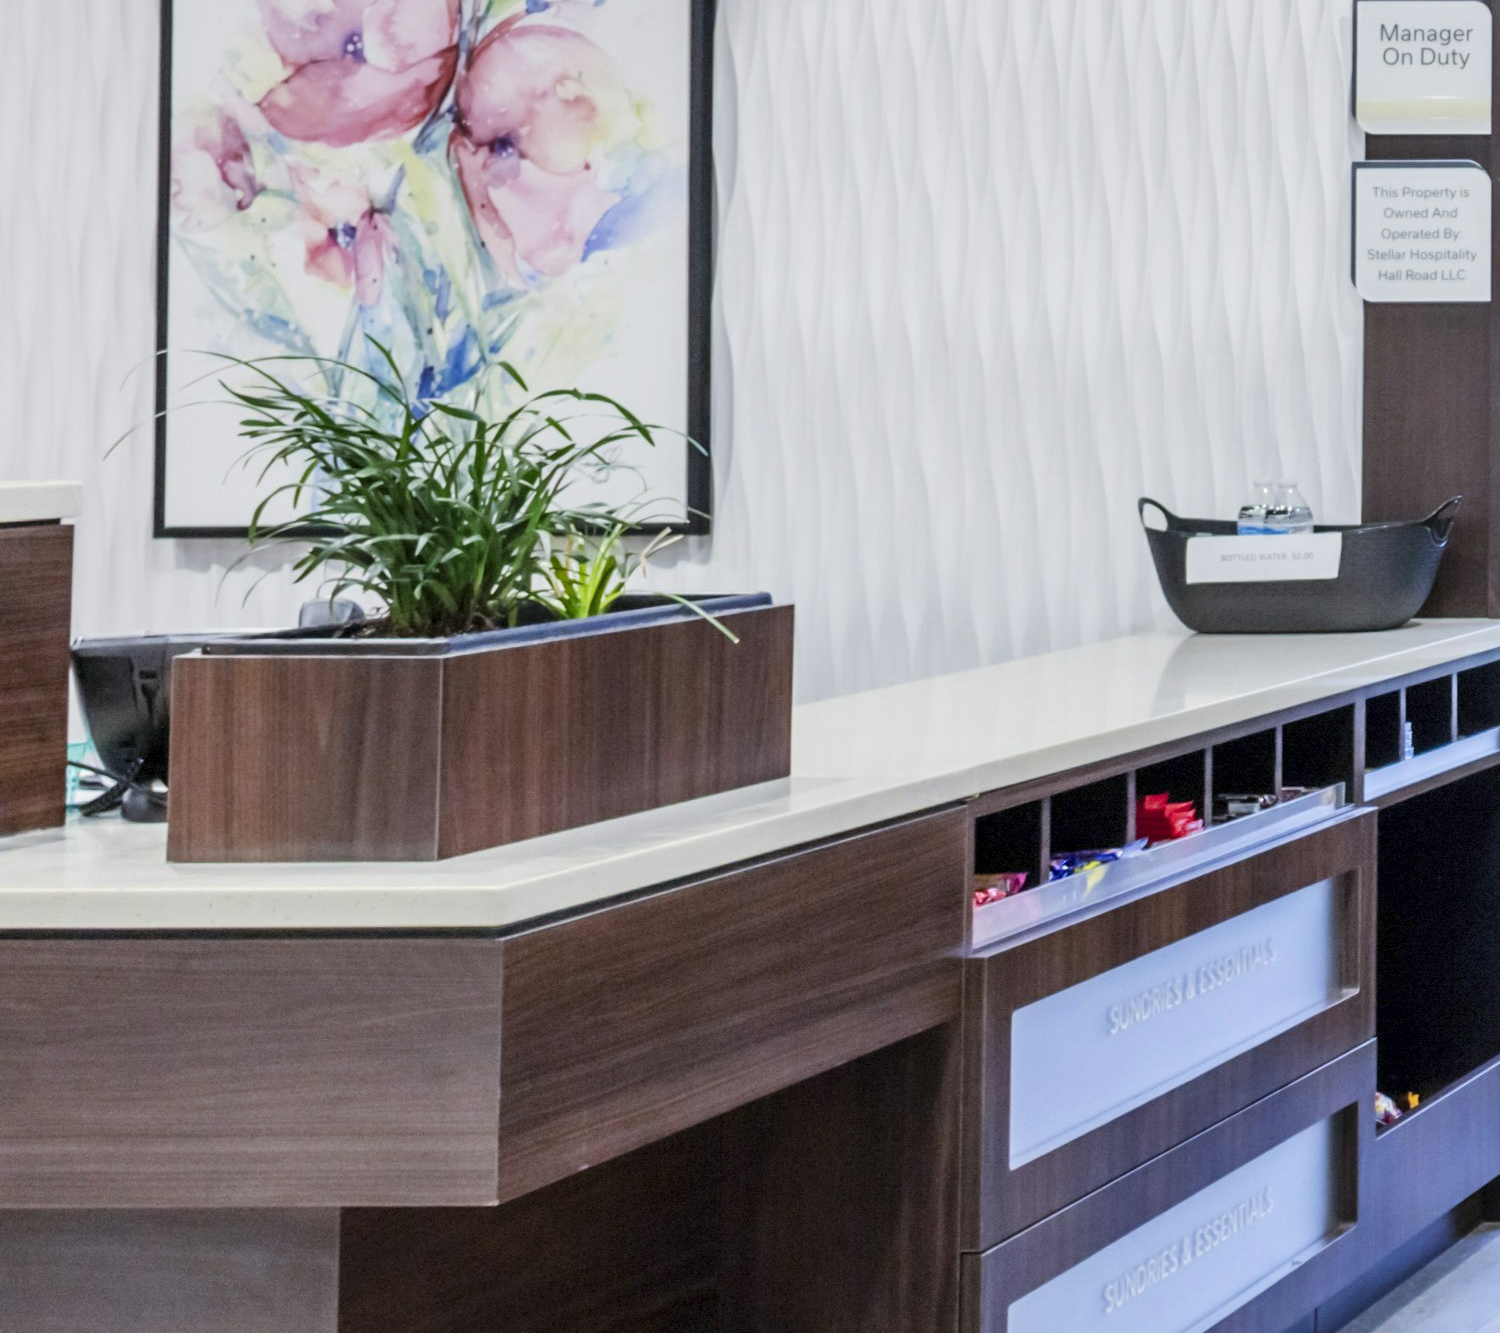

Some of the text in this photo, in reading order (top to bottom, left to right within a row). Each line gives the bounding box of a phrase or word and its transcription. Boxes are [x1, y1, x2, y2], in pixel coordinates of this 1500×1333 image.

[1380, 23, 1474, 45] Manager
[1383, 47, 1471, 69] On Duty
[1372, 186, 1470, 202] This Property is
[1383, 207, 1458, 219] Owned And
[1380, 228, 1440, 241] Operated
[1367, 248, 1478, 264] Stellar Hospitality
[1378, 269, 1466, 281] Hall Road LLC
[1108, 936, 1278, 1036] SUNDRIES & ESSENTIALS
[1102, 1186, 1276, 1316] SUNDRIES & ESSENTIALS
